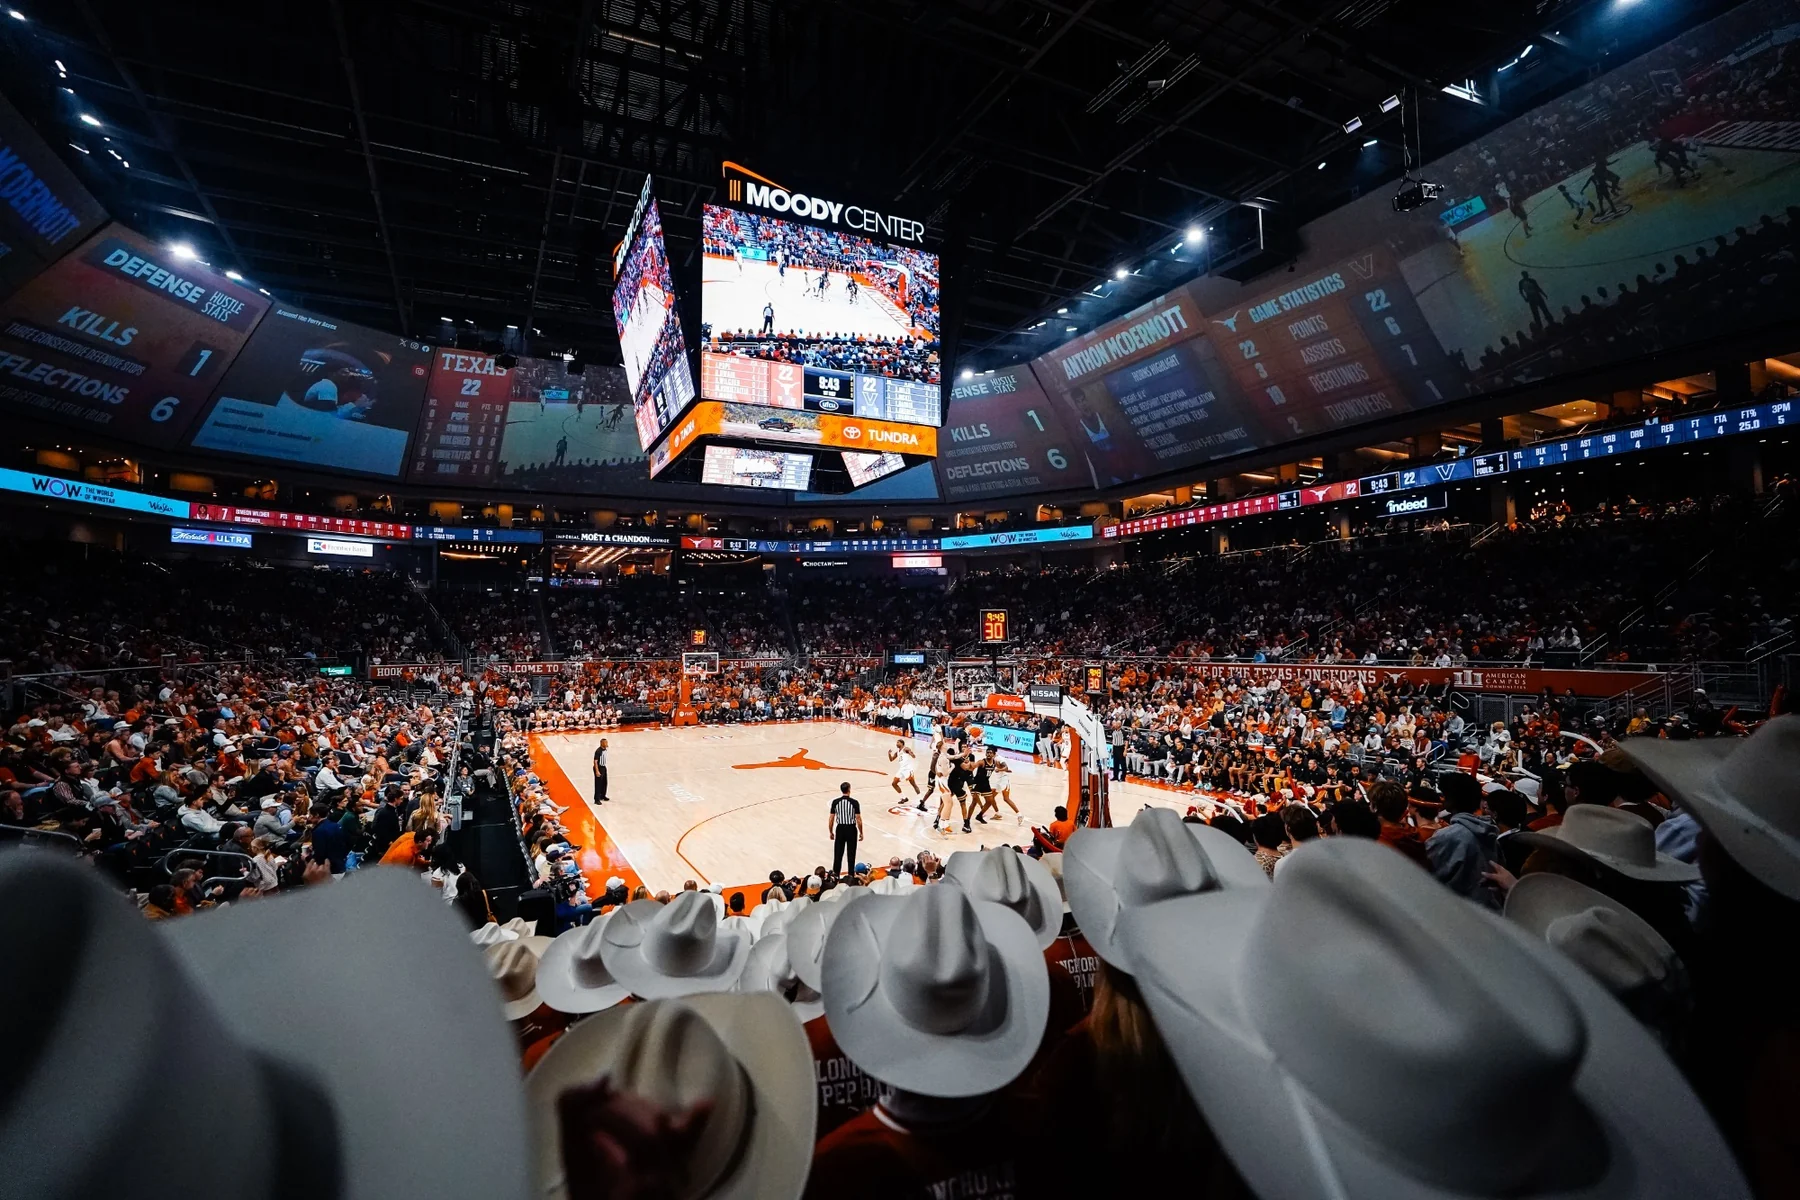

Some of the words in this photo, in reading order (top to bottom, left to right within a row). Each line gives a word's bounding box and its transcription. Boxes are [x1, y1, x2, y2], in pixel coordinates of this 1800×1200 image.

[746, 182, 843, 223] MOODY
[844, 205, 925, 243] CENTER
[103, 248, 205, 304] DEFENSE
[209, 291, 245, 315] HUSTLE
[1248, 299, 1282, 324] GAME
[1278, 272, 1346, 311] STATISTICS
[1365, 288, 1391, 312] 22
[201, 302, 232, 322] STATS
[58, 306, 138, 346] KILLS
[1288, 314, 1329, 341] POINTS
[1383, 316, 1401, 337] 6
[1062, 342, 1111, 380] ANTHON
[1105, 305, 1188, 361] MCDERMOTT
[1300, 338, 1346, 365] ASSISTS
[189, 350, 212, 376] 1
[0, 350, 130, 405] FLECTIONS
[778, 365, 794, 381] 22
[1308, 362, 1370, 394] REBOUNDS
[461, 378, 482, 396] 22
[818, 376, 840, 392] 9:43
[862, 377, 877, 392] 22
[150, 396, 180, 423] 6
[1027, 410, 1045, 432] 1
[1535, 447, 1547, 456] BLK
[1580, 439, 1591, 448] AST
[1661, 423, 1674, 434] REB
[1691, 419, 1700, 428] FT
[1714, 414, 1728, 424] FTA
[1740, 408, 1757, 420] FT%
[1772, 402, 1791, 414] 3PM
[868, 429, 919, 445] TUNDRA
[951, 423, 991, 443] KILLS
[1635, 439, 1641, 449] 4
[1665, 435, 1671, 444] 7
[1693, 430, 1699, 439] 1
[1717, 425, 1724, 435] 4
[1738, 419, 1761, 432] 25.0
[1778, 415, 1785, 425] 5
[946, 457, 1030, 480] DEFLECTIONS
[1047, 449, 1067, 470] 6
[1371, 478, 1389, 491] 9:43
[1403, 471, 1416, 485] 22
[96, 489, 115, 498] WORLD
[1346, 483, 1357, 495] 22
[222, 508, 229, 520] 7
[1386, 497, 1428, 513] indeed
[217, 535, 250, 545] ULTRA
[604, 534, 611, 542] &
[612, 535, 650, 544] CHANDON
[713, 540, 722, 548] 22
[749, 541, 757, 549] 22
[987, 613, 1005, 622] 9:43
[693, 636, 704, 644] 30
[985, 623, 1003, 639] 30
[377, 667, 403, 677] HOOK
[546, 664, 559, 673] TO
[1211, 667, 1223, 678] OF
[1254, 668, 1292, 681] TEXAS
[1088, 678, 1100, 689] 30
[1031, 690, 1060, 698] NISSAN
[821, 1080, 857, 1107] PEP
